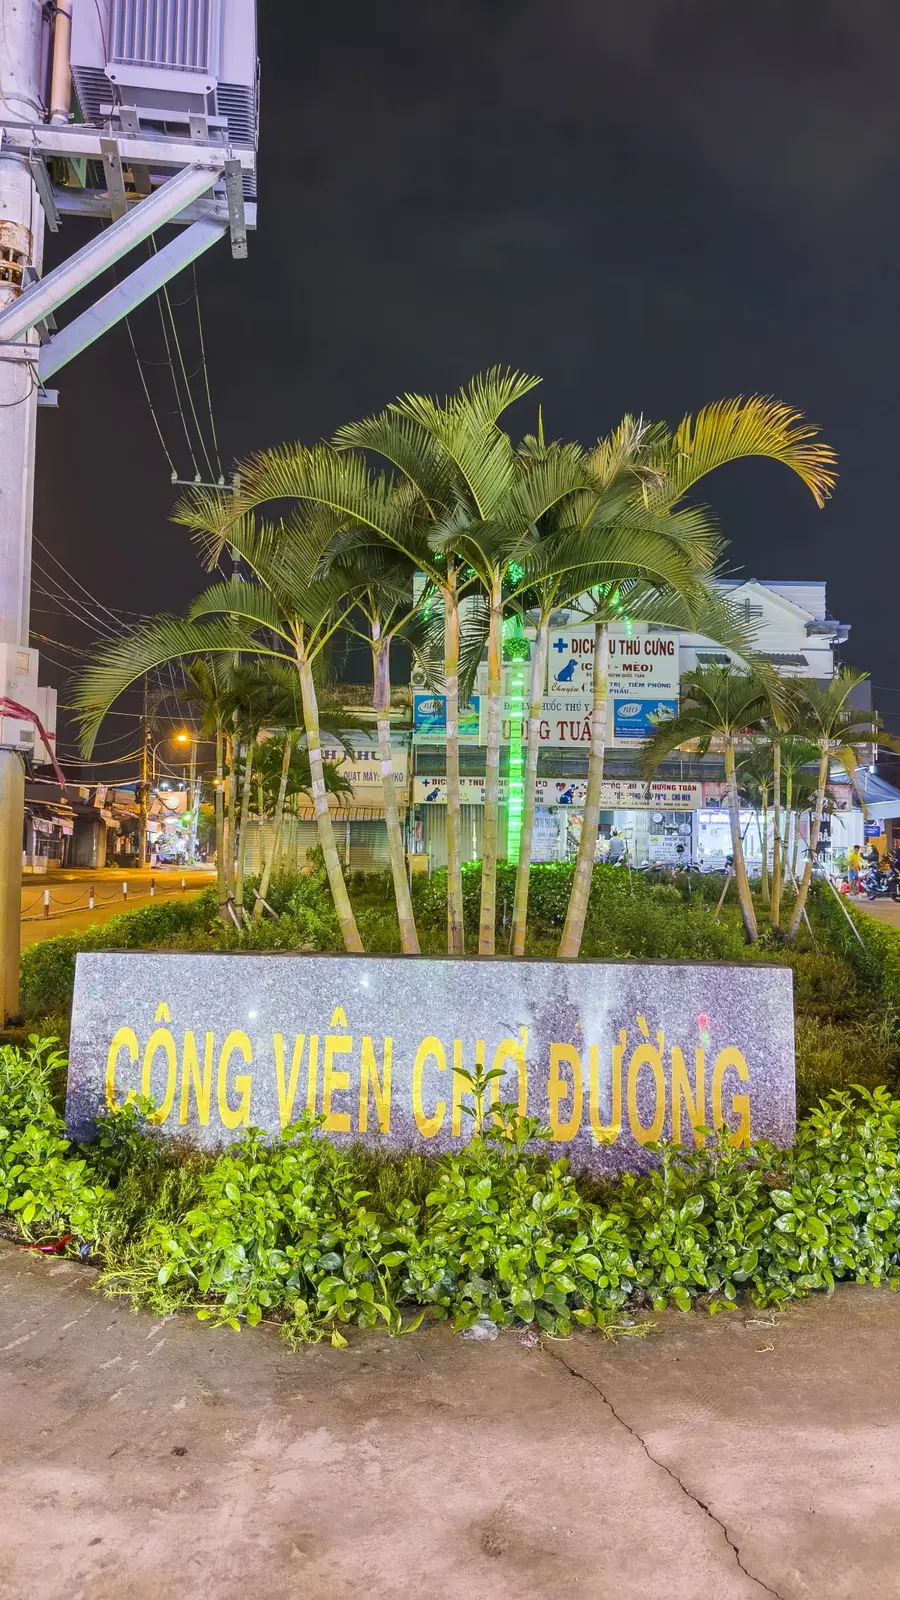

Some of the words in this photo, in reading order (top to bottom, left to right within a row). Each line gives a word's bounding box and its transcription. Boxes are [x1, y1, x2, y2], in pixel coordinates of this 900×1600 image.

[619, 636, 641, 656] THÚ
[644, 638, 675, 656] CƯNG
[565, 701, 581, 711] THÚ
[556, 711, 592, 741] TUẤ
[106, 1002, 253, 1130] CÔNG
[274, 1006, 393, 1134] VIÊN
[547, 1015, 751, 1149] ĐƯỜNG
